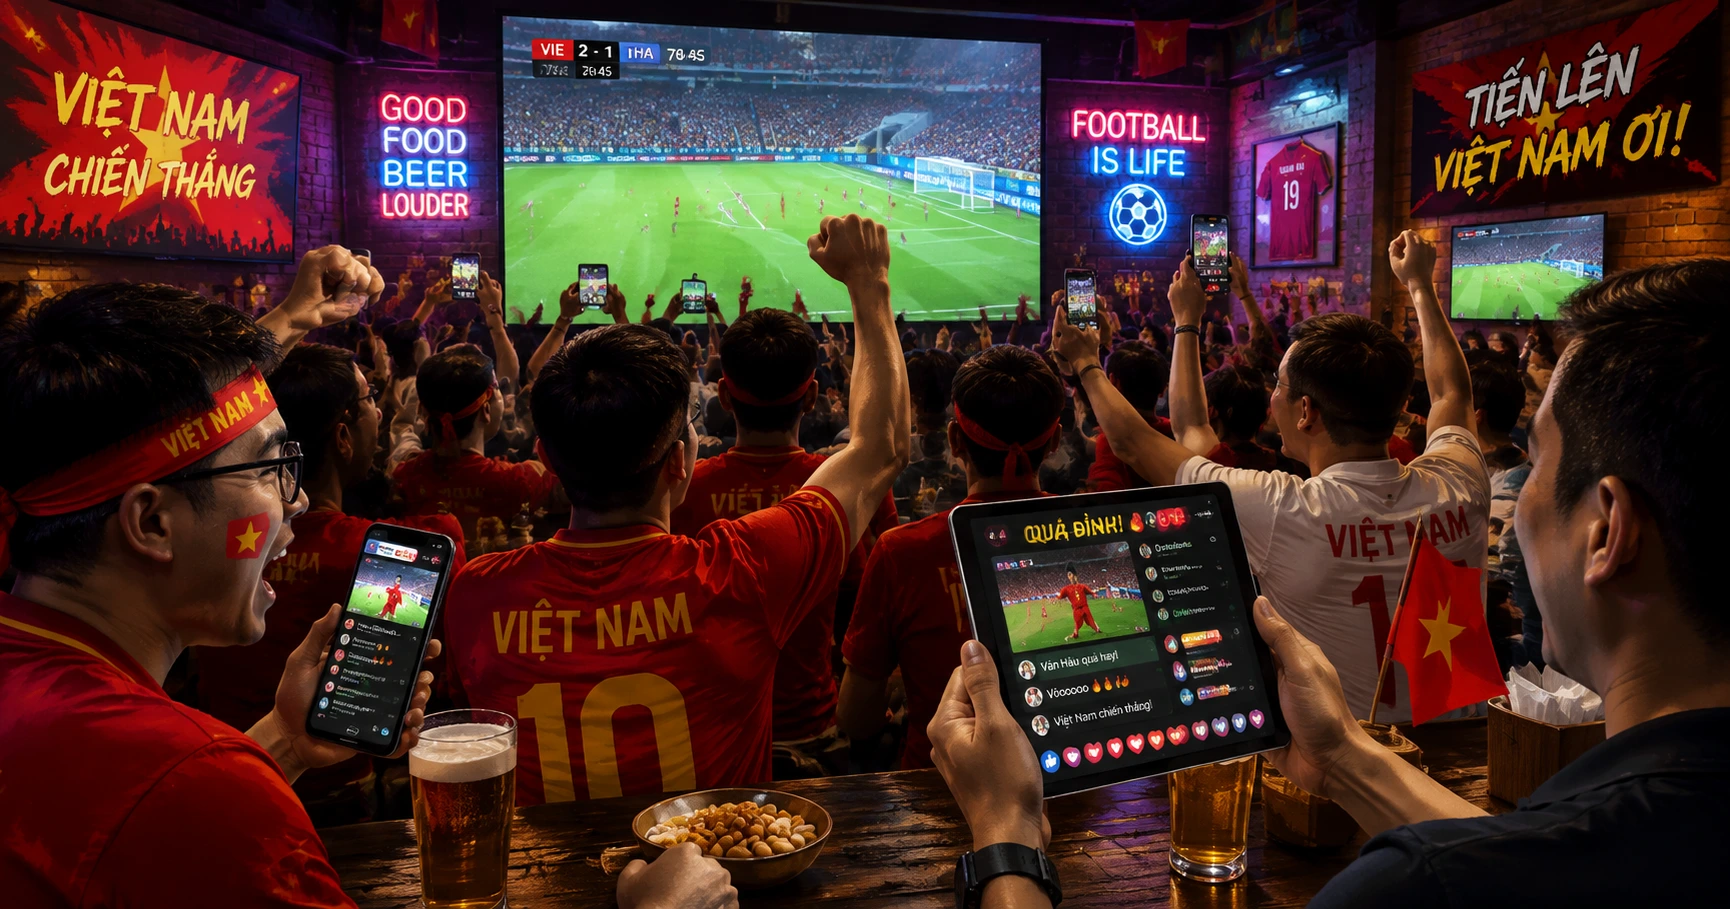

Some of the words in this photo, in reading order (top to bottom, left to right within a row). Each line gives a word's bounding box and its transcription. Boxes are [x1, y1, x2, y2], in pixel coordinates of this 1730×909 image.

[540, 43, 565, 57] VIE
[578, 44, 588, 57] 2
[604, 46, 612, 58] 1
[54, 66, 158, 138] VIỆT
[163, 90, 250, 144] NAM
[381, 93, 467, 123] GOOD
[383, 126, 467, 154] FOOD
[1072, 109, 1206, 141] FOOTBALL
[44, 143, 152, 196] CHIẾN
[158, 147, 256, 200] THẮNG
[384, 159, 468, 188] BEER
[1093, 146, 1119, 174] IS
[1129, 147, 1186, 176] LIFE
[1434, 134, 1512, 196] VIỆT
[1517, 120, 1611, 181] NAM
[382, 192, 469, 217] LOUDER
[1283, 180, 1300, 211] 19
[208, 391, 254, 433] NAM
[1325, 516, 1395, 562] VIỆT
[493, 598, 581, 662] VIỆT
[596, 592, 693, 650] NAM
[1074, 711, 1098, 723] Nam
[517, 672, 697, 803] 10
